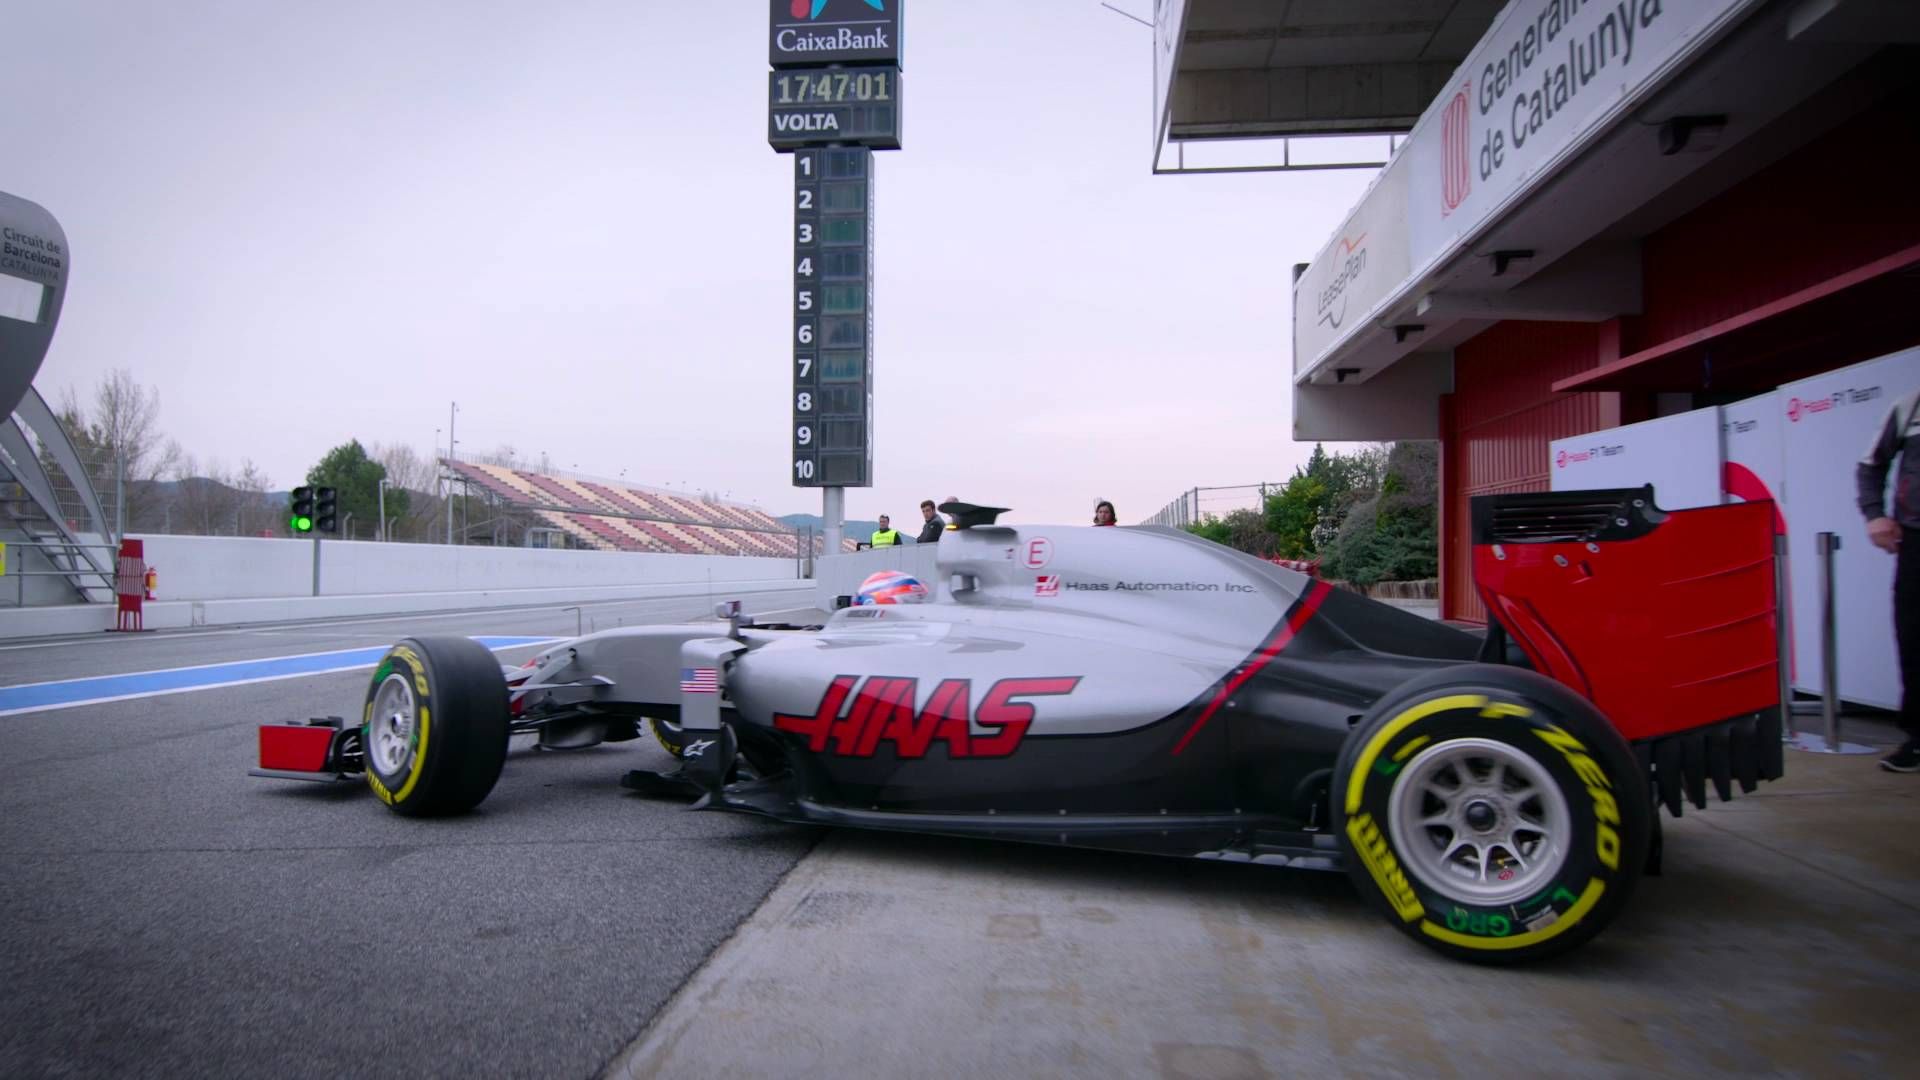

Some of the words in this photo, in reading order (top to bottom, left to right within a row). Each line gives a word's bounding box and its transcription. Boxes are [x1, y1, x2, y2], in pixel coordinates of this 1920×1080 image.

[776, 27, 889, 51] CaixaBank
[777, 72, 889, 103] 17:47:01
[1480, 128, 1504, 182] de
[1512, 0, 1662, 149] Catalunya
[774, 113, 839, 131] VOLTA
[799, 156, 811, 175] 1
[798, 190, 813, 209] 2
[3, 227, 44, 250] Circuit
[46, 239, 61, 254] de
[798, 224, 813, 242] 3
[4, 241, 61, 268] Barcelona
[797, 257, 813, 276] 4
[798, 291, 813, 310] 5
[798, 325, 812, 343] 6
[798, 359, 812, 377] 7
[797, 392, 812, 411] 8
[797, 426, 811, 444] 9
[795, 459, 813, 478] 10
[1029, 541, 1045, 565] E
[1065, 581, 1109, 591] Haas
[1115, 581, 1219, 592] Automation
[1225, 582, 1257, 593] Inc.
[773, 674, 1086, 759] HAAS
